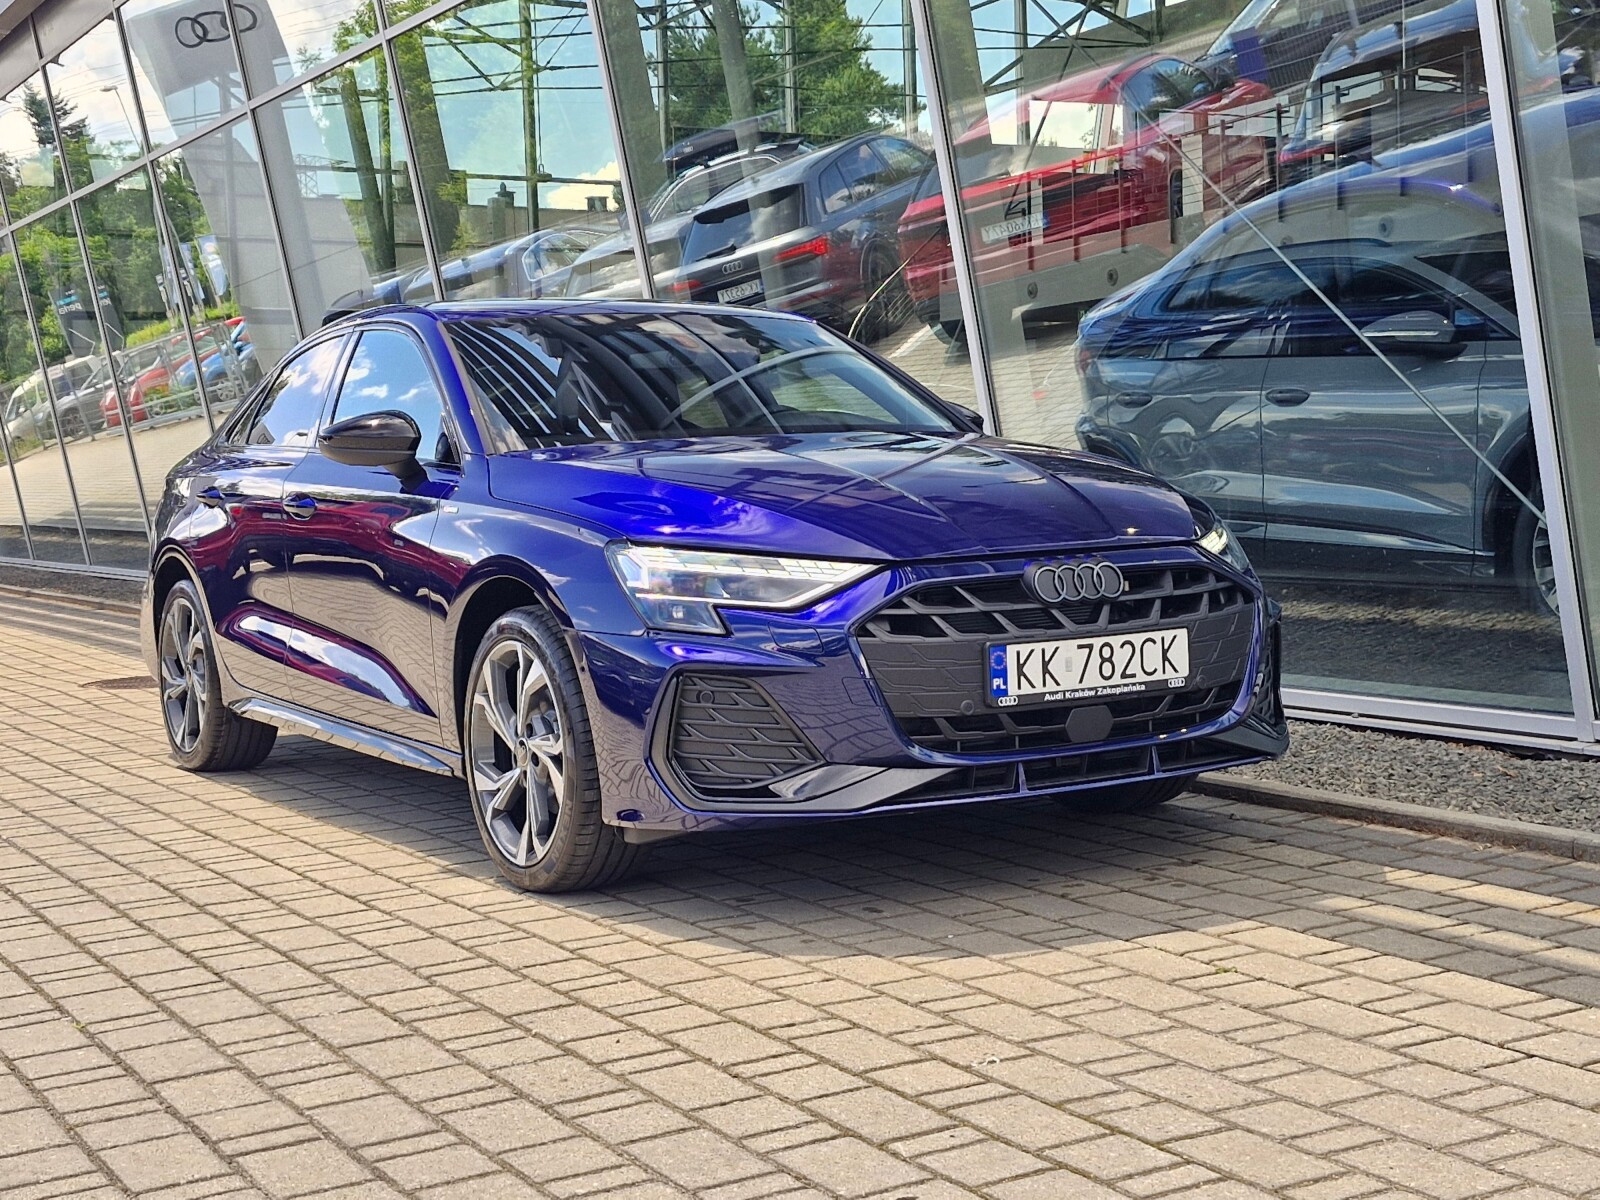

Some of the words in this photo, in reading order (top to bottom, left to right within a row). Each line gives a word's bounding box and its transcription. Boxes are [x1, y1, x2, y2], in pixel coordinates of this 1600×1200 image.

[1016, 646, 1061, 690] KK
[1076, 634, 1179, 685] 782CK
[993, 677, 1007, 690] PL
[1044, 693, 1064, 701] Audi
[1065, 688, 1096, 699] Kraków
[1097, 683, 1146, 696] Zakopiańska
